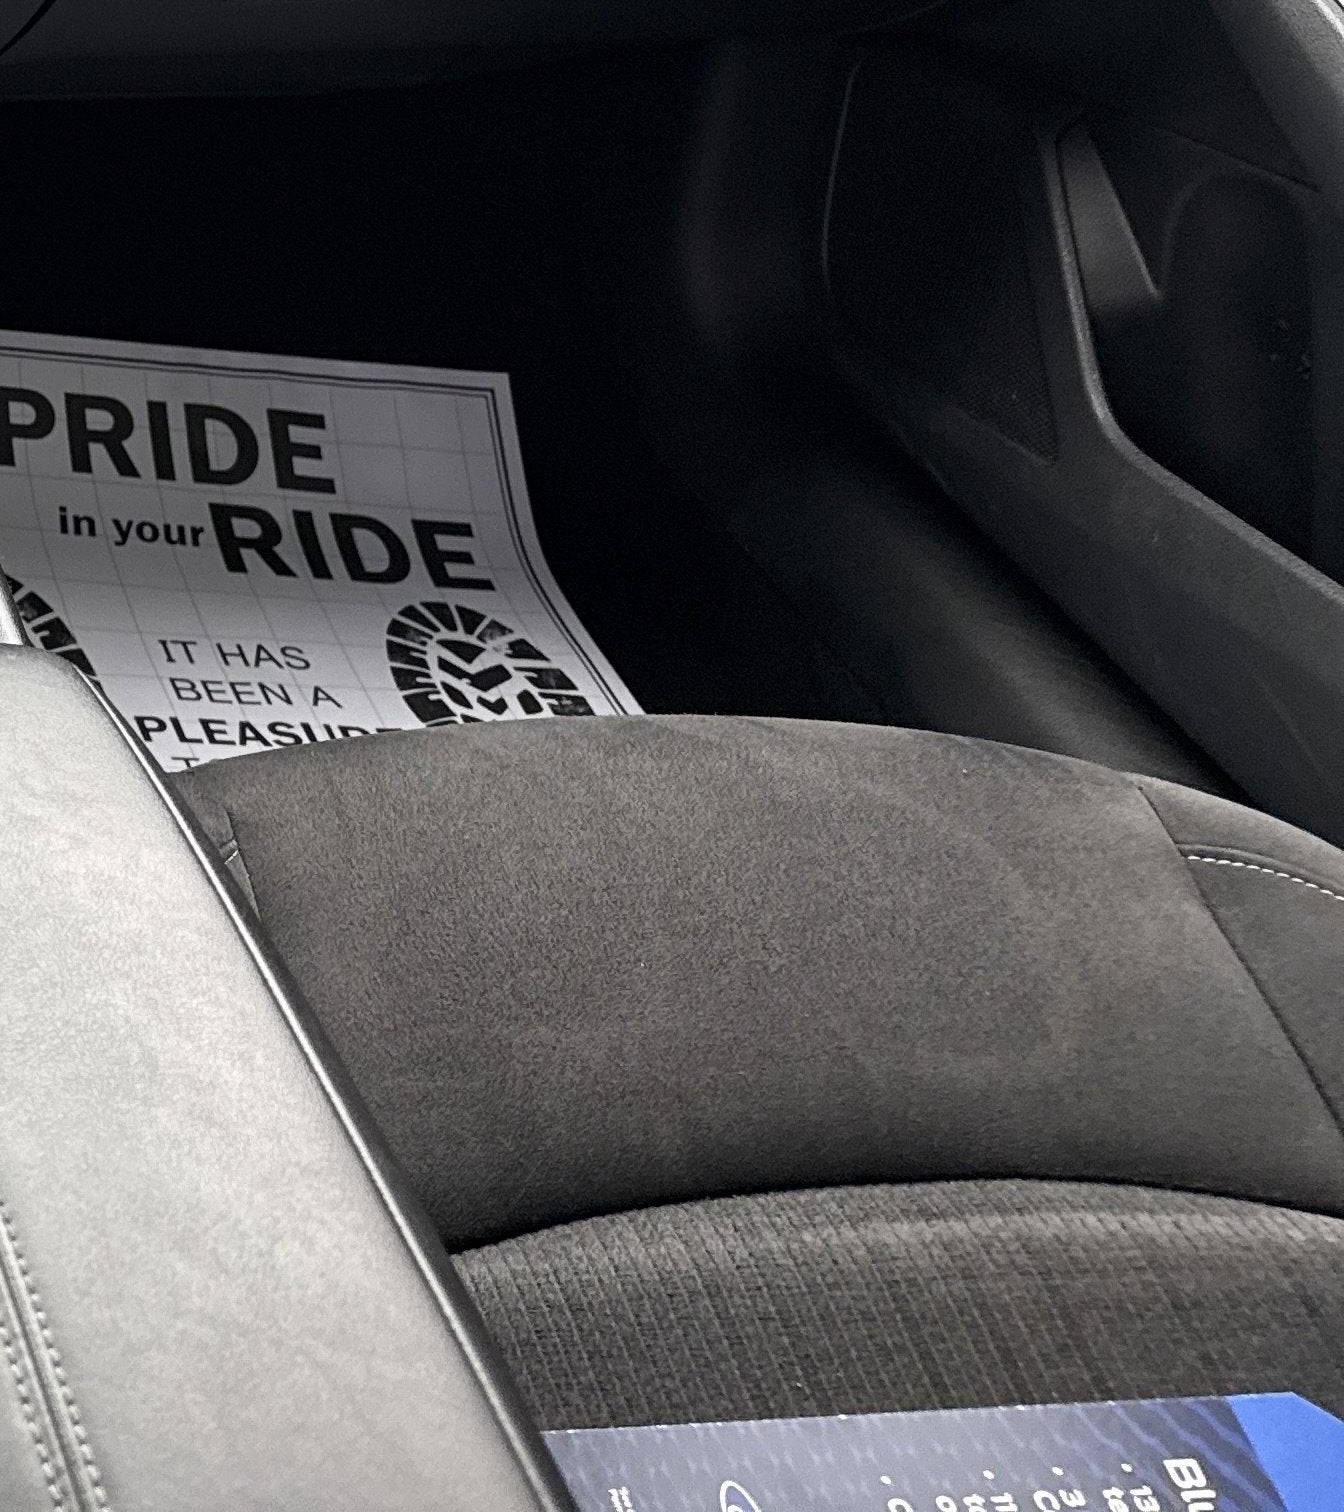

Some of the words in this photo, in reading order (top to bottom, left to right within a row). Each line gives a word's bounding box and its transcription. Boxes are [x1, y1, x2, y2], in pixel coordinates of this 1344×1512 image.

[59, 506, 97, 537] in
[112, 514, 205, 548] your
[207, 502, 497, 592] RIDE
[157, 639, 197, 664] IT
[215, 642, 311, 670] HAS
[168, 676, 294, 706] BEEN
[312, 685, 344, 709] A
